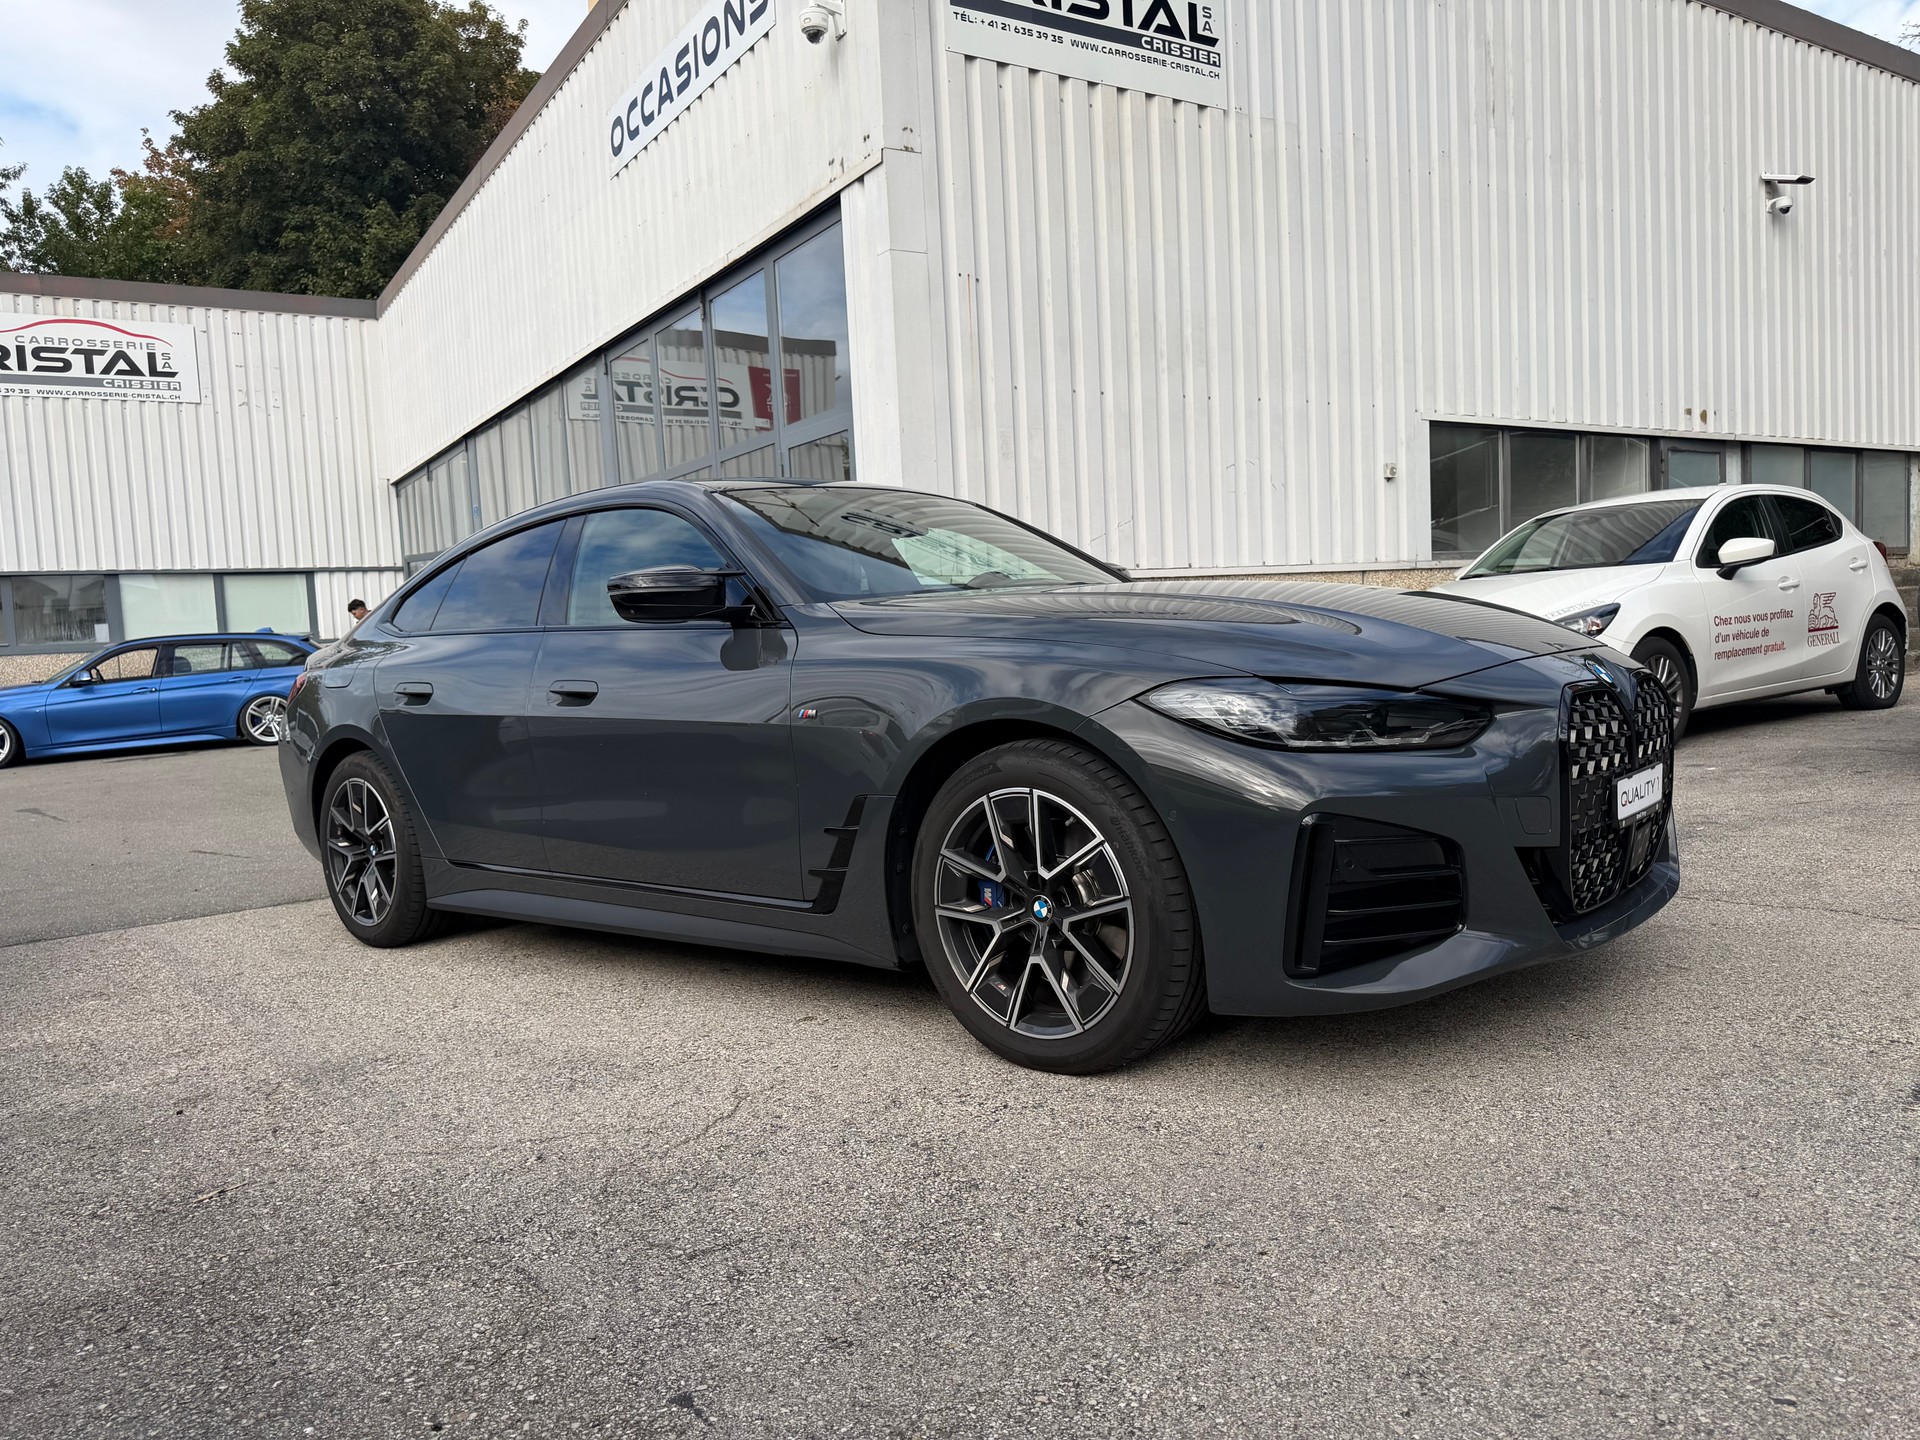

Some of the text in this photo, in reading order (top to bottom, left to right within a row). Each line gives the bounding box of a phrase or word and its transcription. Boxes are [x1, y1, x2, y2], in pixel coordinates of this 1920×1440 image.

[953, 10, 978, 24] TÉL:
[1001, 22, 1011, 32] 21
[1013, 25, 1034, 37] 635
[1036, 30, 1049, 41] 39
[1051, 33, 1064, 44] 35
[1070, 38, 1220, 80] WWW.CARROSSERIE-CRISTAL.CH
[1141, 36, 1220, 66] CRISSIER
[14, 335, 156, 351] CARROSSERIE
[102, 379, 181, 390] CRISSIER
[36, 389, 181, 400] WWW.CARROSSERIE-CRISTAL.CH
[1713, 608, 1794, 627] Chez nous vous profitez
[1714, 627, 1770, 644] d'un véhicule de
[1807, 631, 1841, 647] GENERALI
[1714, 640, 1787, 660] remplacement gratuit.
[1620, 778, 1656, 807] QUALITY
